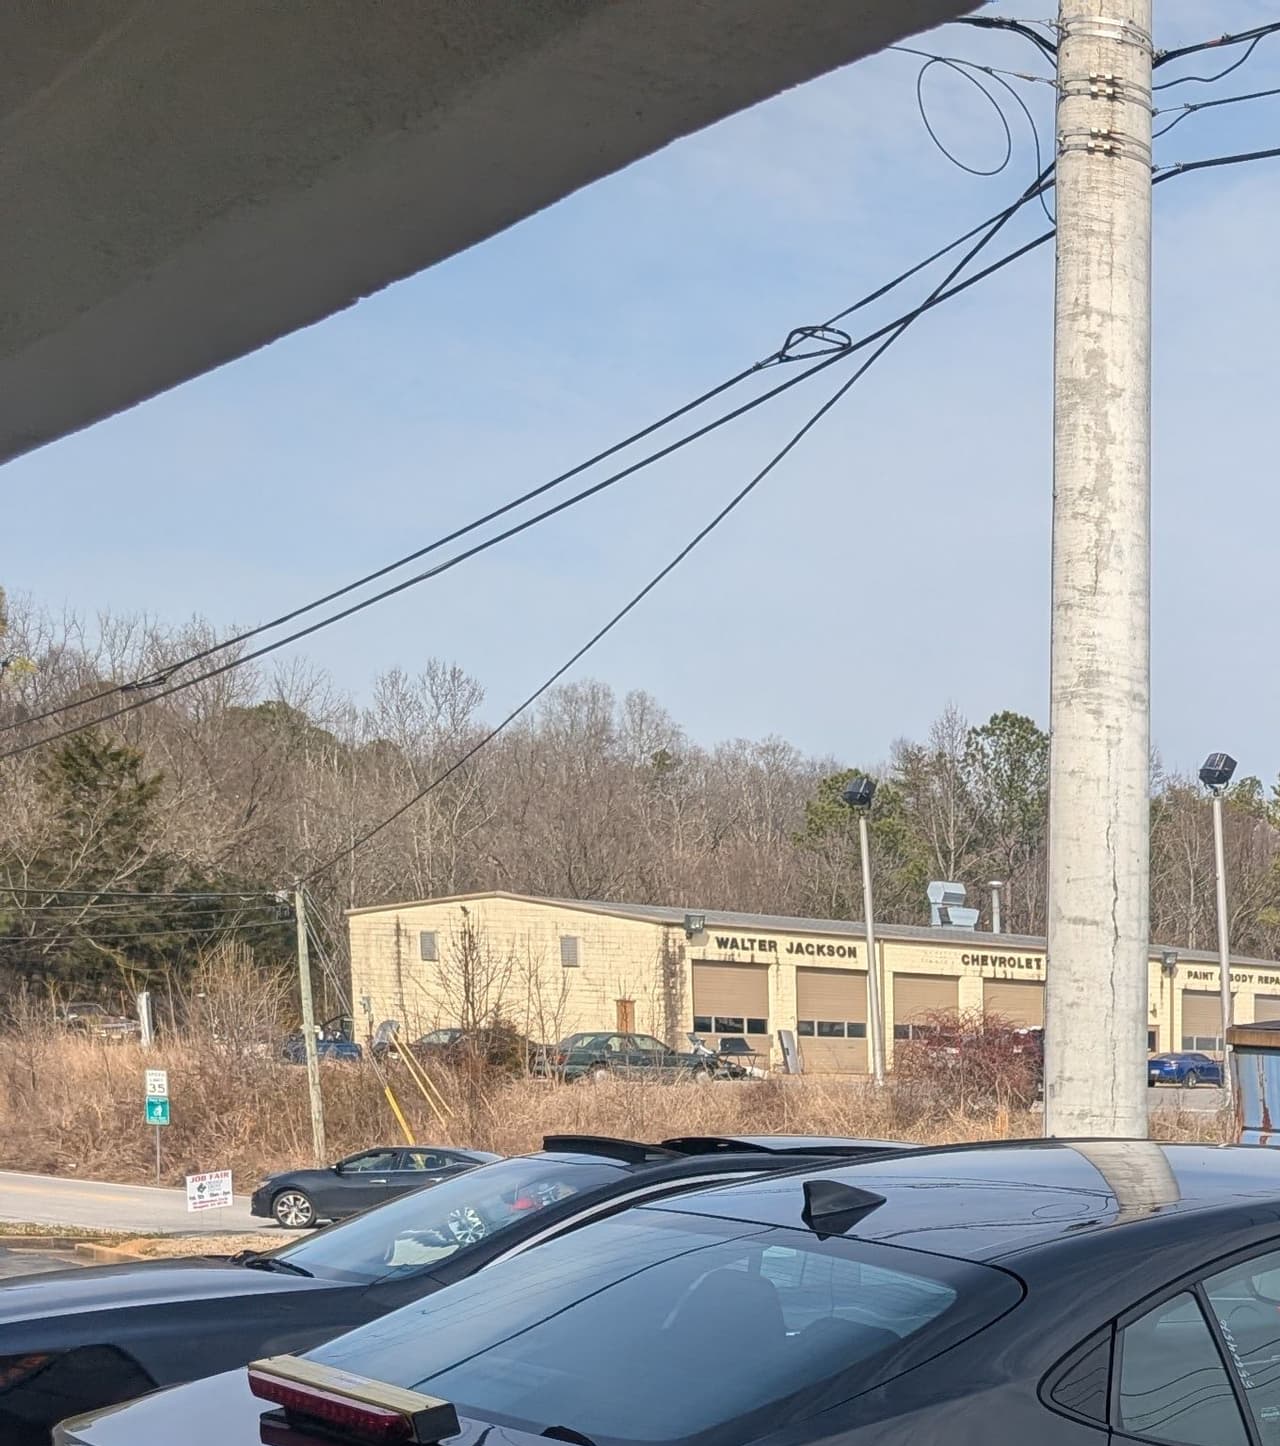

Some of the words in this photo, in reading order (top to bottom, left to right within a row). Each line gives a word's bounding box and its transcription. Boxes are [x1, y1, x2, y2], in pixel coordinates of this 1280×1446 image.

[715, 936, 777, 953] WALTER
[786, 941, 857, 959] JACKSON
[961, 953, 1042, 971] CHEVROLET
[1187, 970, 1214, 981] PAINT
[149, 1083, 165, 1093] 35
[191, 1175, 206, 1183] JOB
[209, 1172, 229, 1180] FAIR
